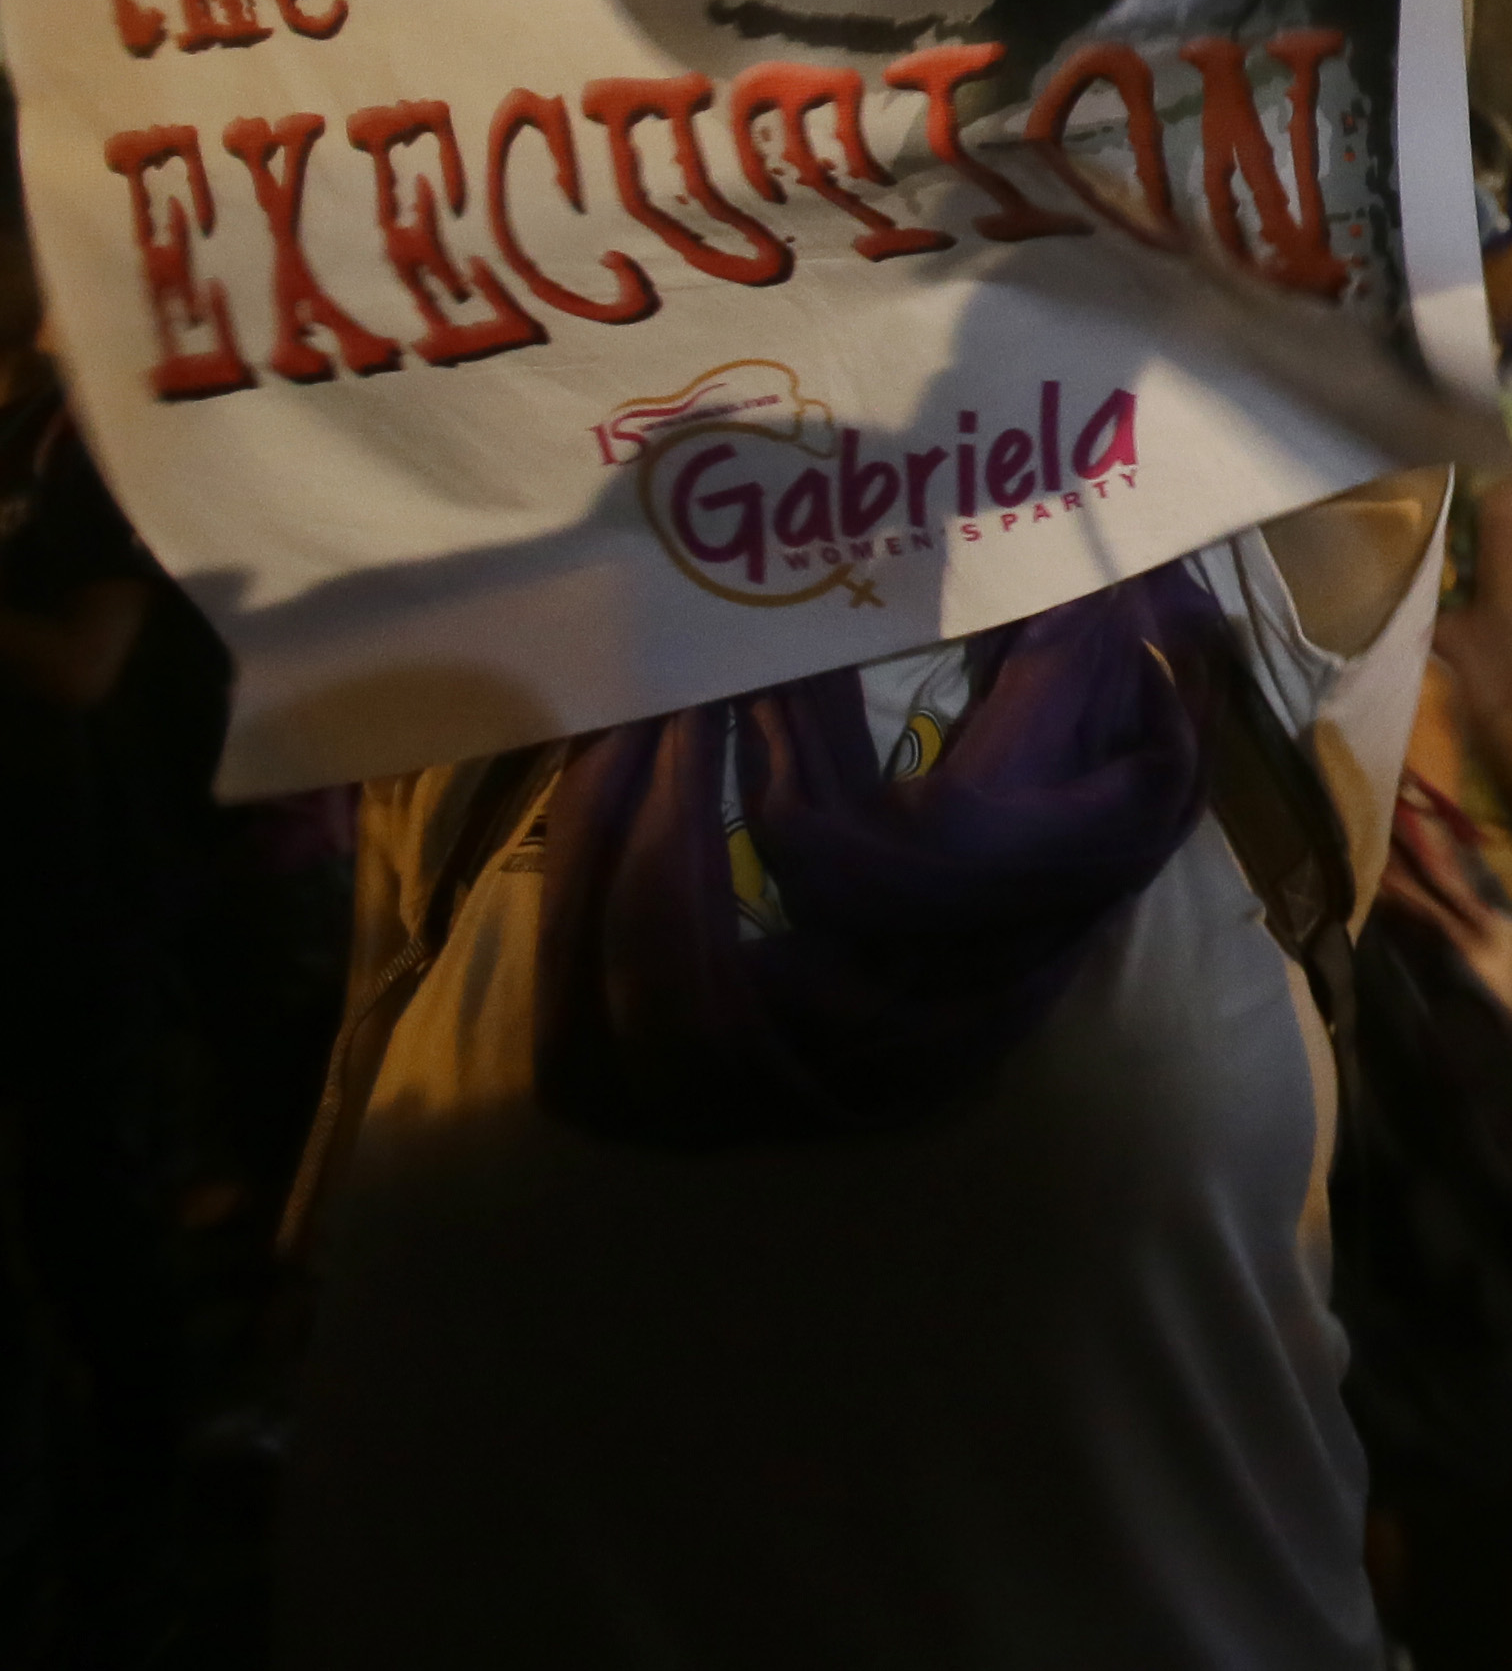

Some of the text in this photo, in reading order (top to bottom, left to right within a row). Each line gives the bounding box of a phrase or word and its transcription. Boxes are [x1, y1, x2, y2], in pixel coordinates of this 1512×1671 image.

[104, 27, 1347, 403] EXECUTION
[671, 380, 1137, 585] Gabriela
[1000, 469, 1136, 532] PARTY
